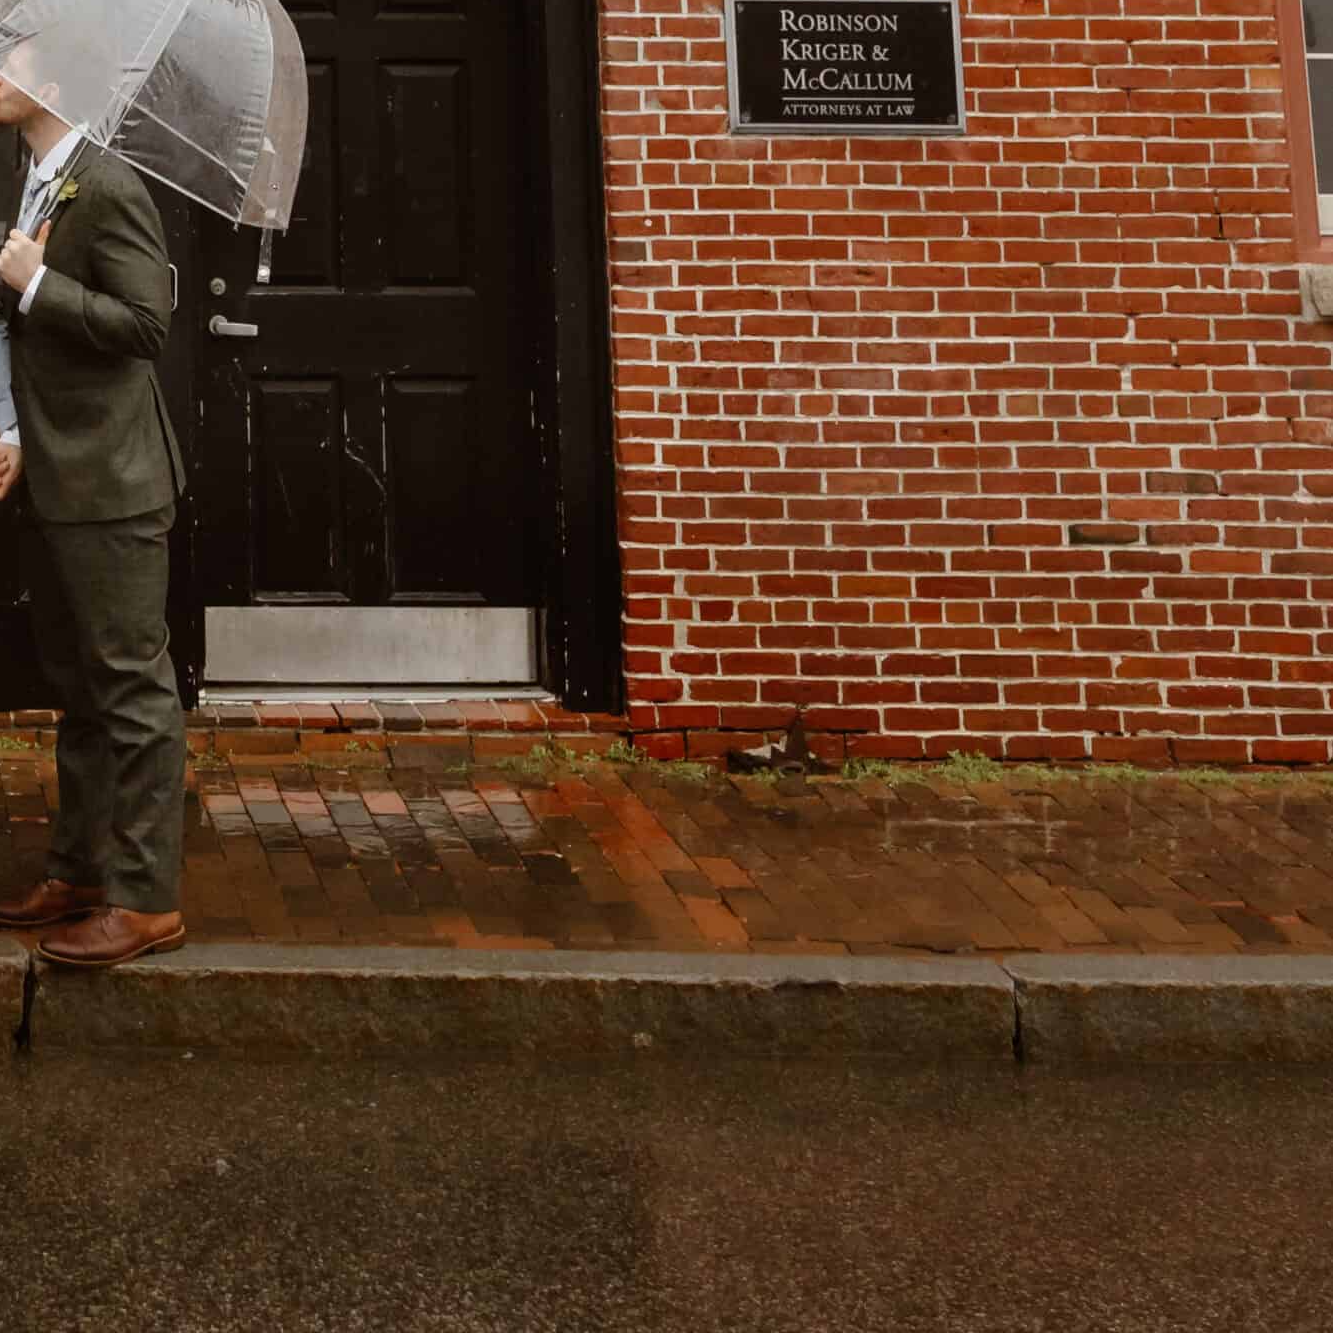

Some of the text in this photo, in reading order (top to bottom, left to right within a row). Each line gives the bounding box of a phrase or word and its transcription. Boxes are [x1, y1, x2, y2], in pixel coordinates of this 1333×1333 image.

[779, 8, 898, 33] ROBINSON
[780, 38, 889, 62] KRIGER &
[782, 104, 915, 116] ATTORNEYS AT LAW
